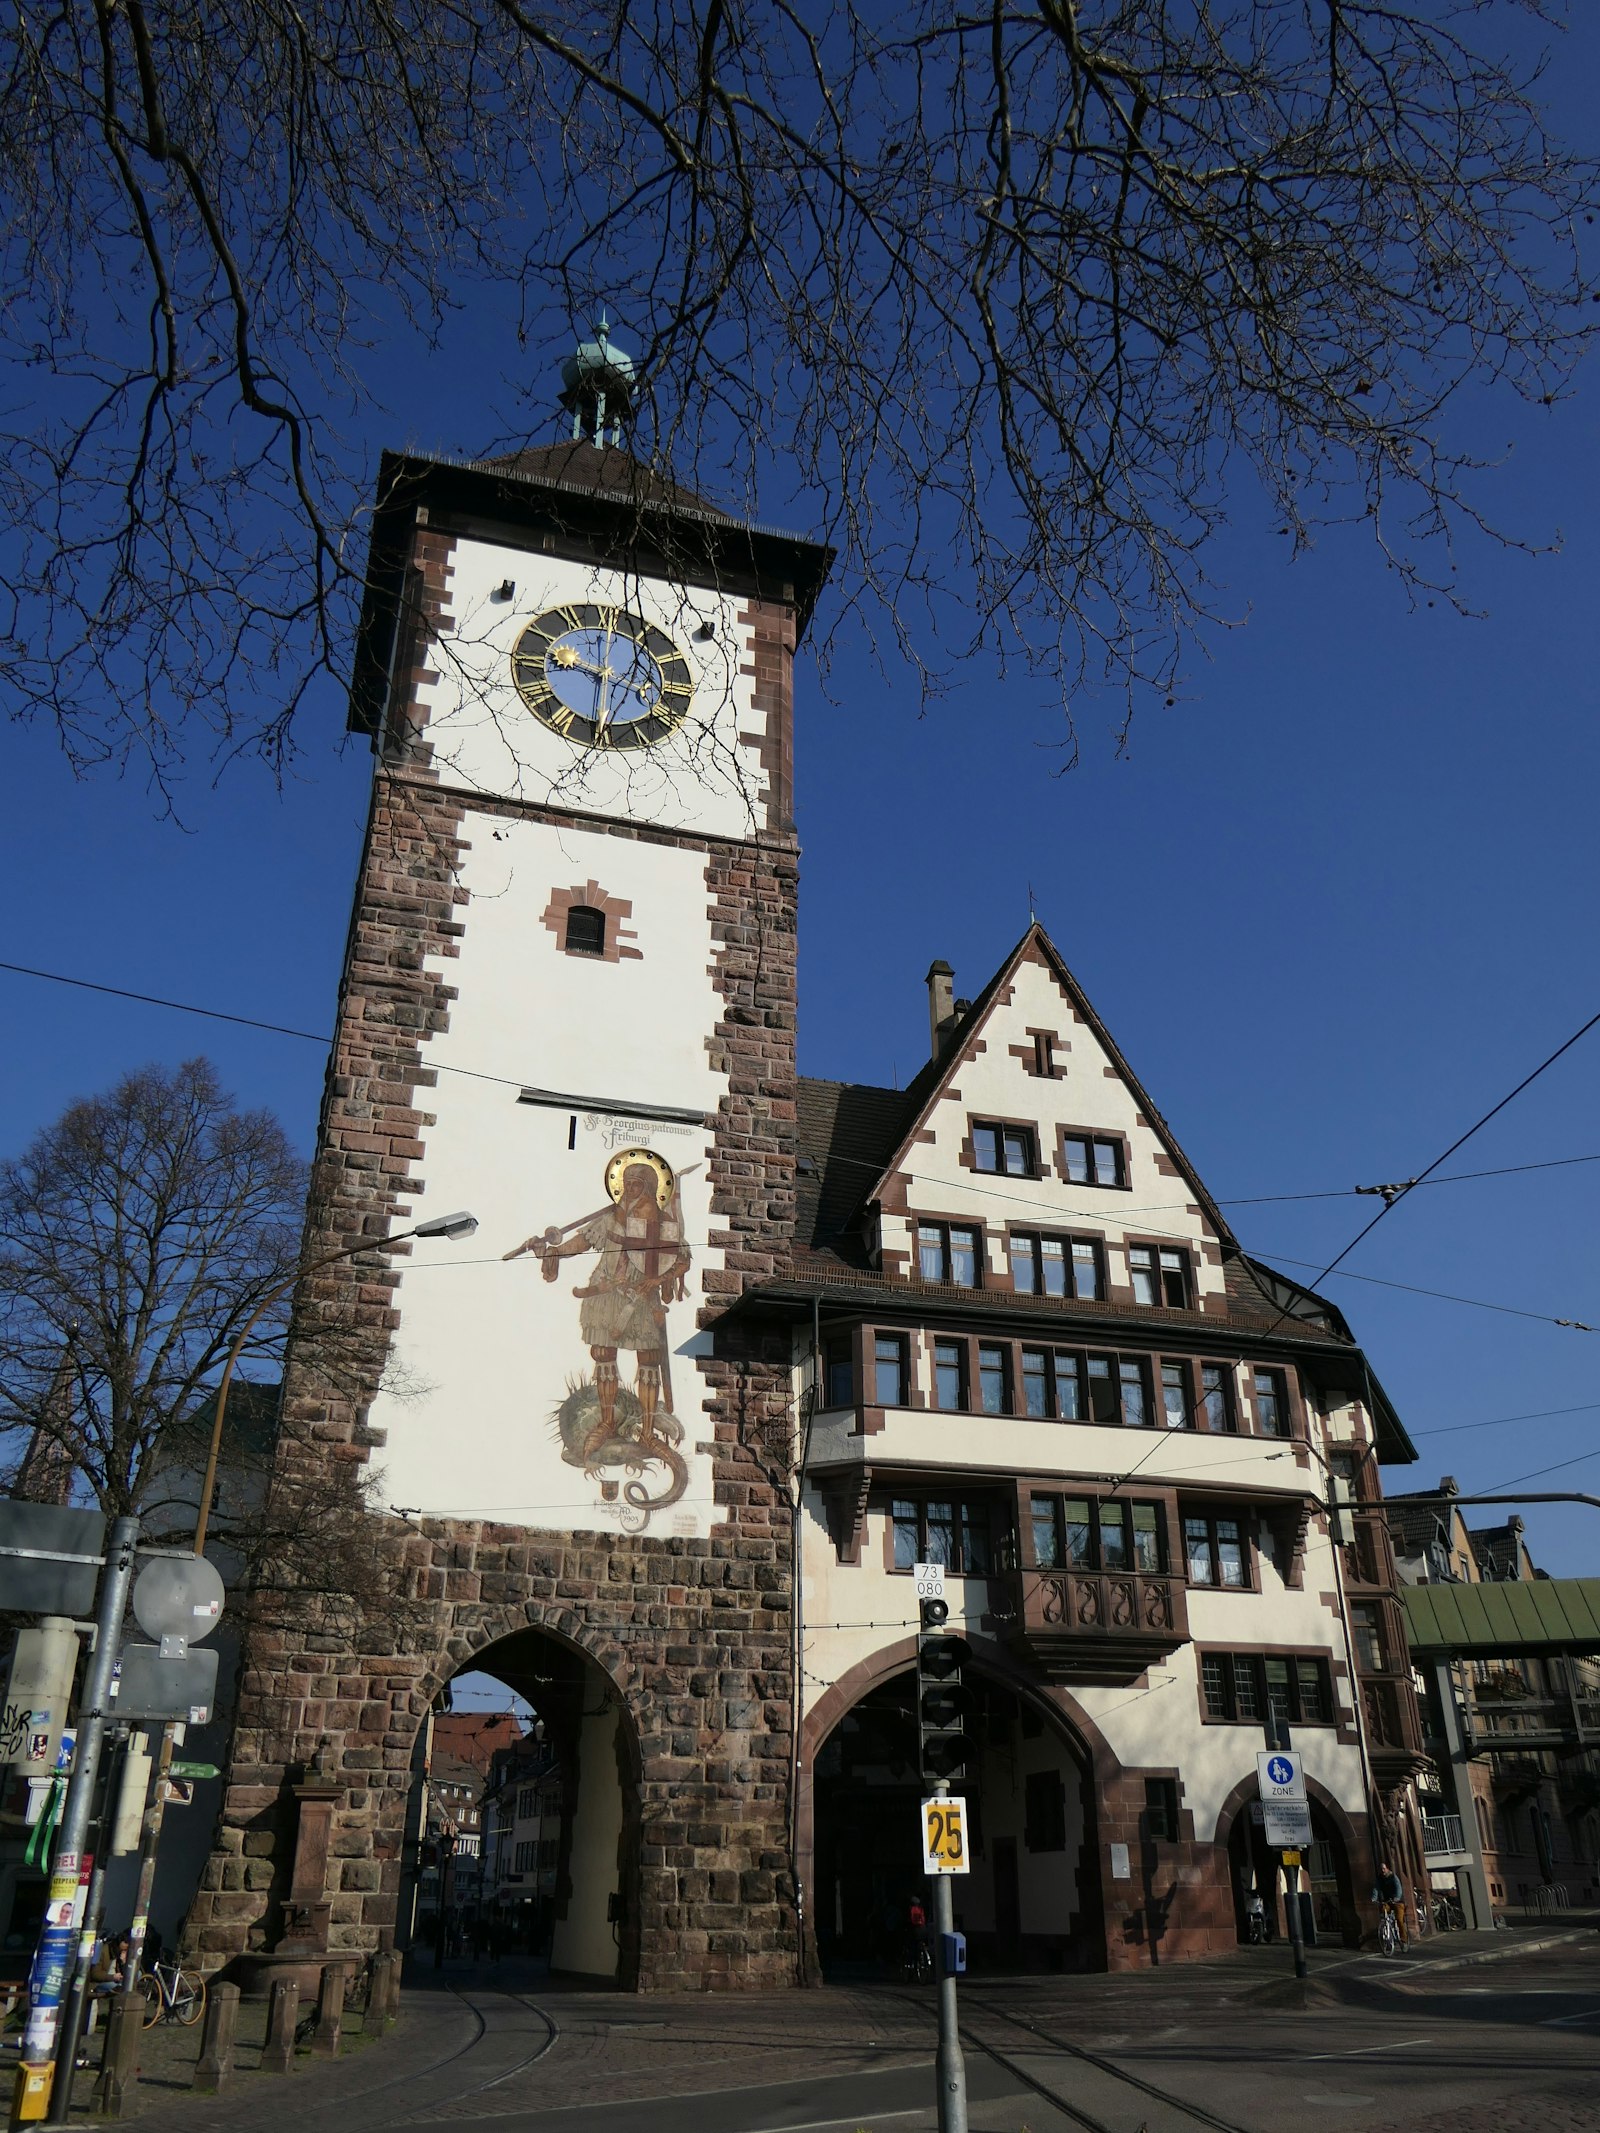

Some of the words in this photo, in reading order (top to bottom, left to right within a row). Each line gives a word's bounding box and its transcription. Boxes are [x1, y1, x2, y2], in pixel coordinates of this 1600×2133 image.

[921, 1565, 938, 1579] 73
[917, 1582, 943, 1596] 080
[1272, 1787, 1295, 1796] ZONE
[927, 1810, 963, 1860] 25
